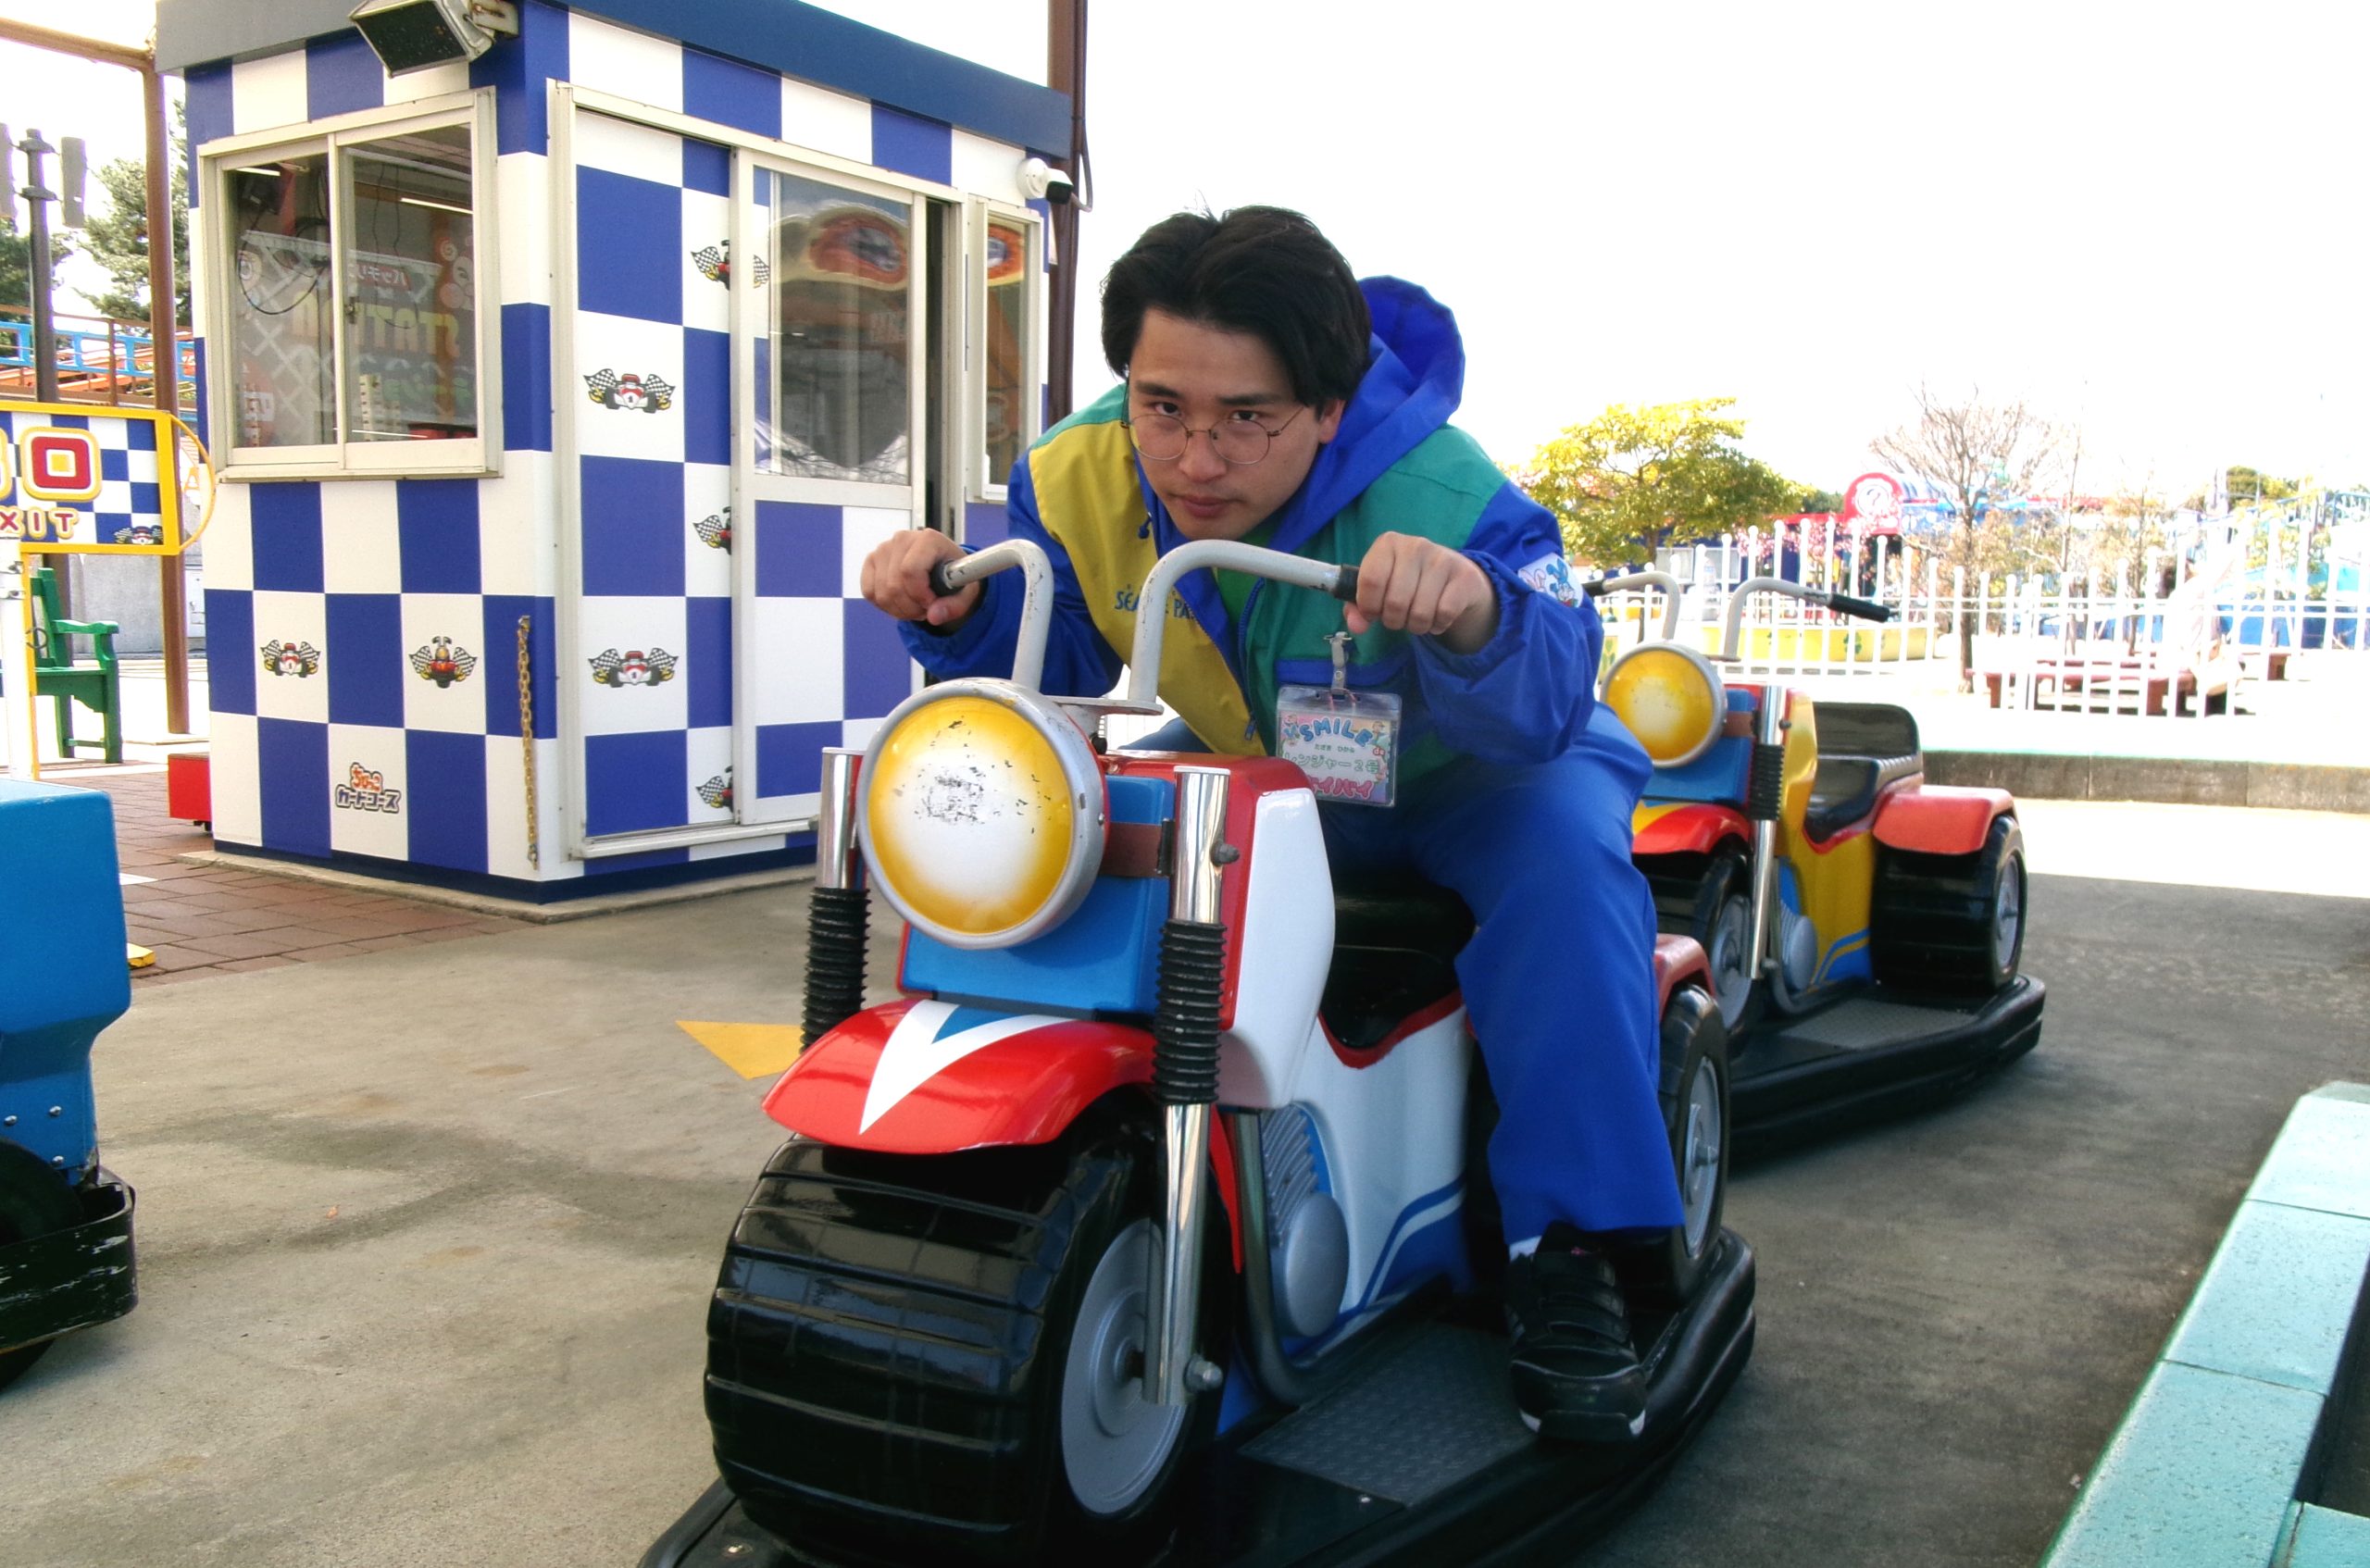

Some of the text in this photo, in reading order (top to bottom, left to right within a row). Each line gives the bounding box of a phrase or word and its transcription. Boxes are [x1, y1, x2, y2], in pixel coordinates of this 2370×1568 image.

[11, 429, 99, 499] 口
[1299, 717, 1373, 748] SMILE
[351, 765, 382, 793] ちびっこ
